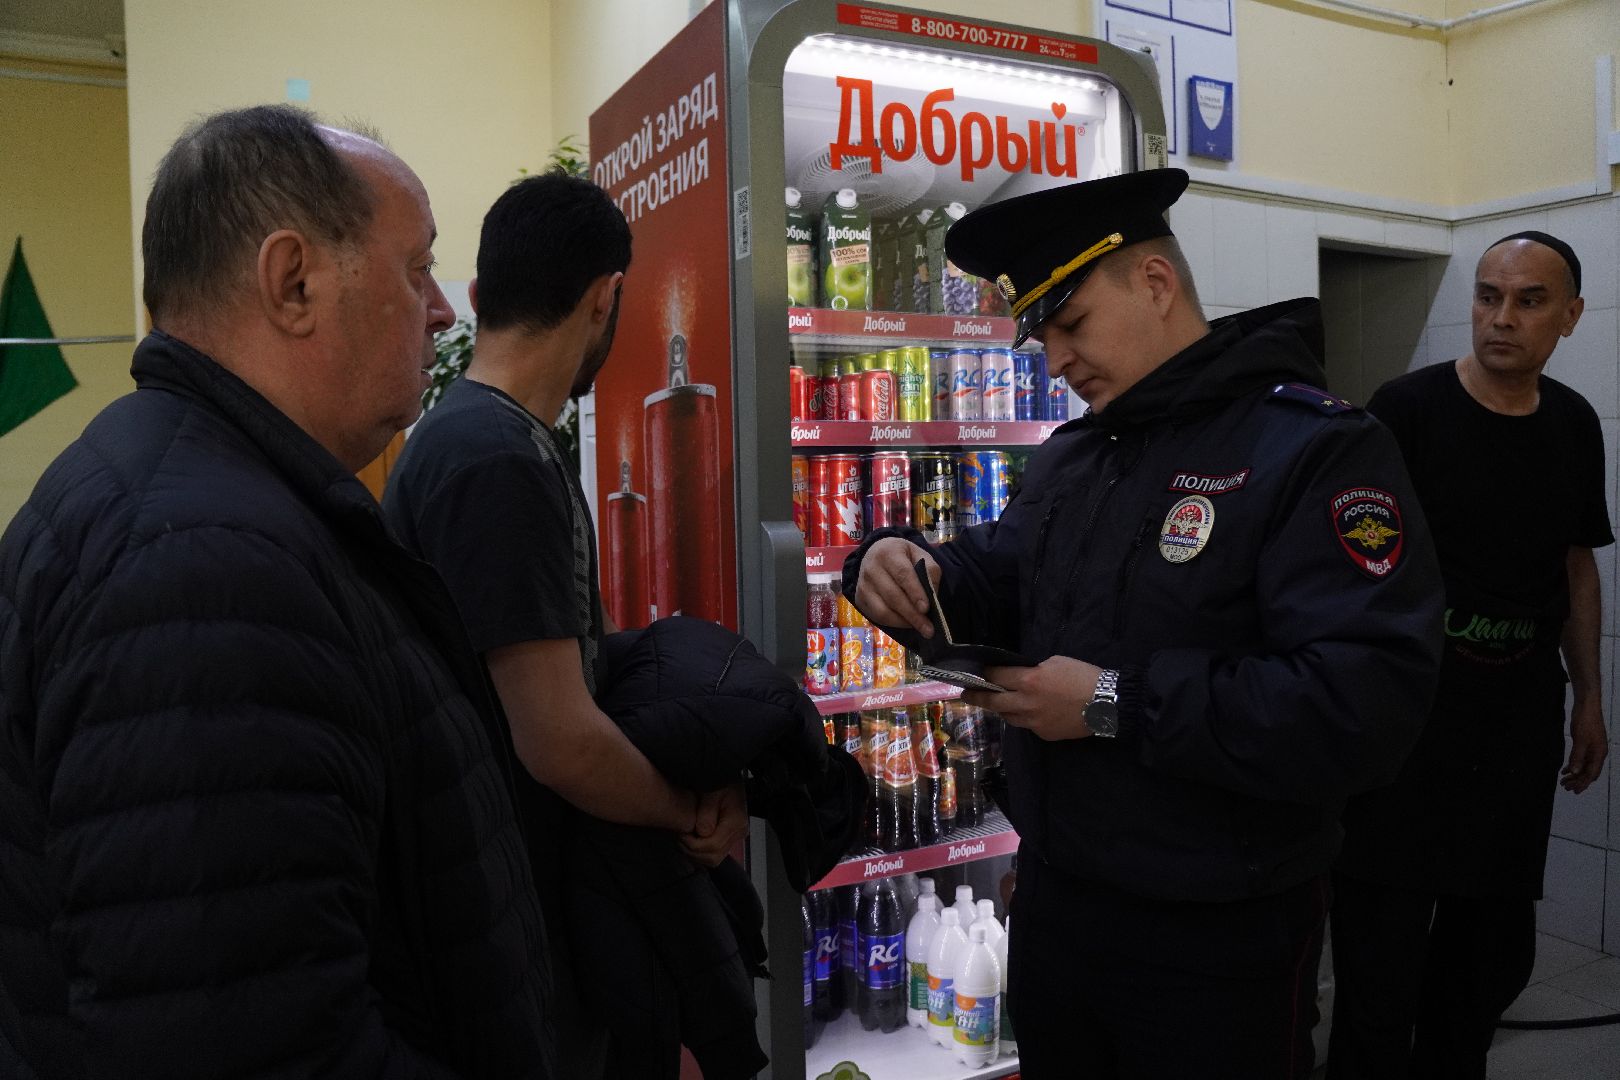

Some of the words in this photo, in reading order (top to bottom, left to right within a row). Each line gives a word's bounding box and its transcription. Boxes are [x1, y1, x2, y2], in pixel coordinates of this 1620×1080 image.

[911, 17, 1028, 50] 8-800-700-7777
[594, 115, 654, 189] ОТКРОЙ
[656, 72, 719, 152] ЗАРЯД
[829, 75, 1079, 183] Добрый
[614, 137, 710, 224] СТРОЕНИЯ
[827, 224, 871, 242] Добрый
[788, 312, 813, 329] рый
[863, 316, 906, 332] Добрый
[952, 320, 993, 336] Добрый
[953, 369, 981, 392] RC
[983, 368, 1011, 392] RC
[791, 425, 821, 440] брый
[870, 425, 913, 440] Добрый
[957, 425, 997, 440] Добрый
[1172, 472, 1246, 492] ПОЛИЦИЯ
[1334, 490, 1394, 511] ПОЛИЦИЯ
[1343, 503, 1390, 522] РОССИЯ
[1164, 535, 1198, 546] ПОЛИЦИЯ
[1365, 558, 1392, 575] МВД
[861, 691, 904, 709] Добрый
[947, 840, 986, 862] Добрый
[863, 855, 905, 878] Добрый
[869, 941, 900, 968] RC
